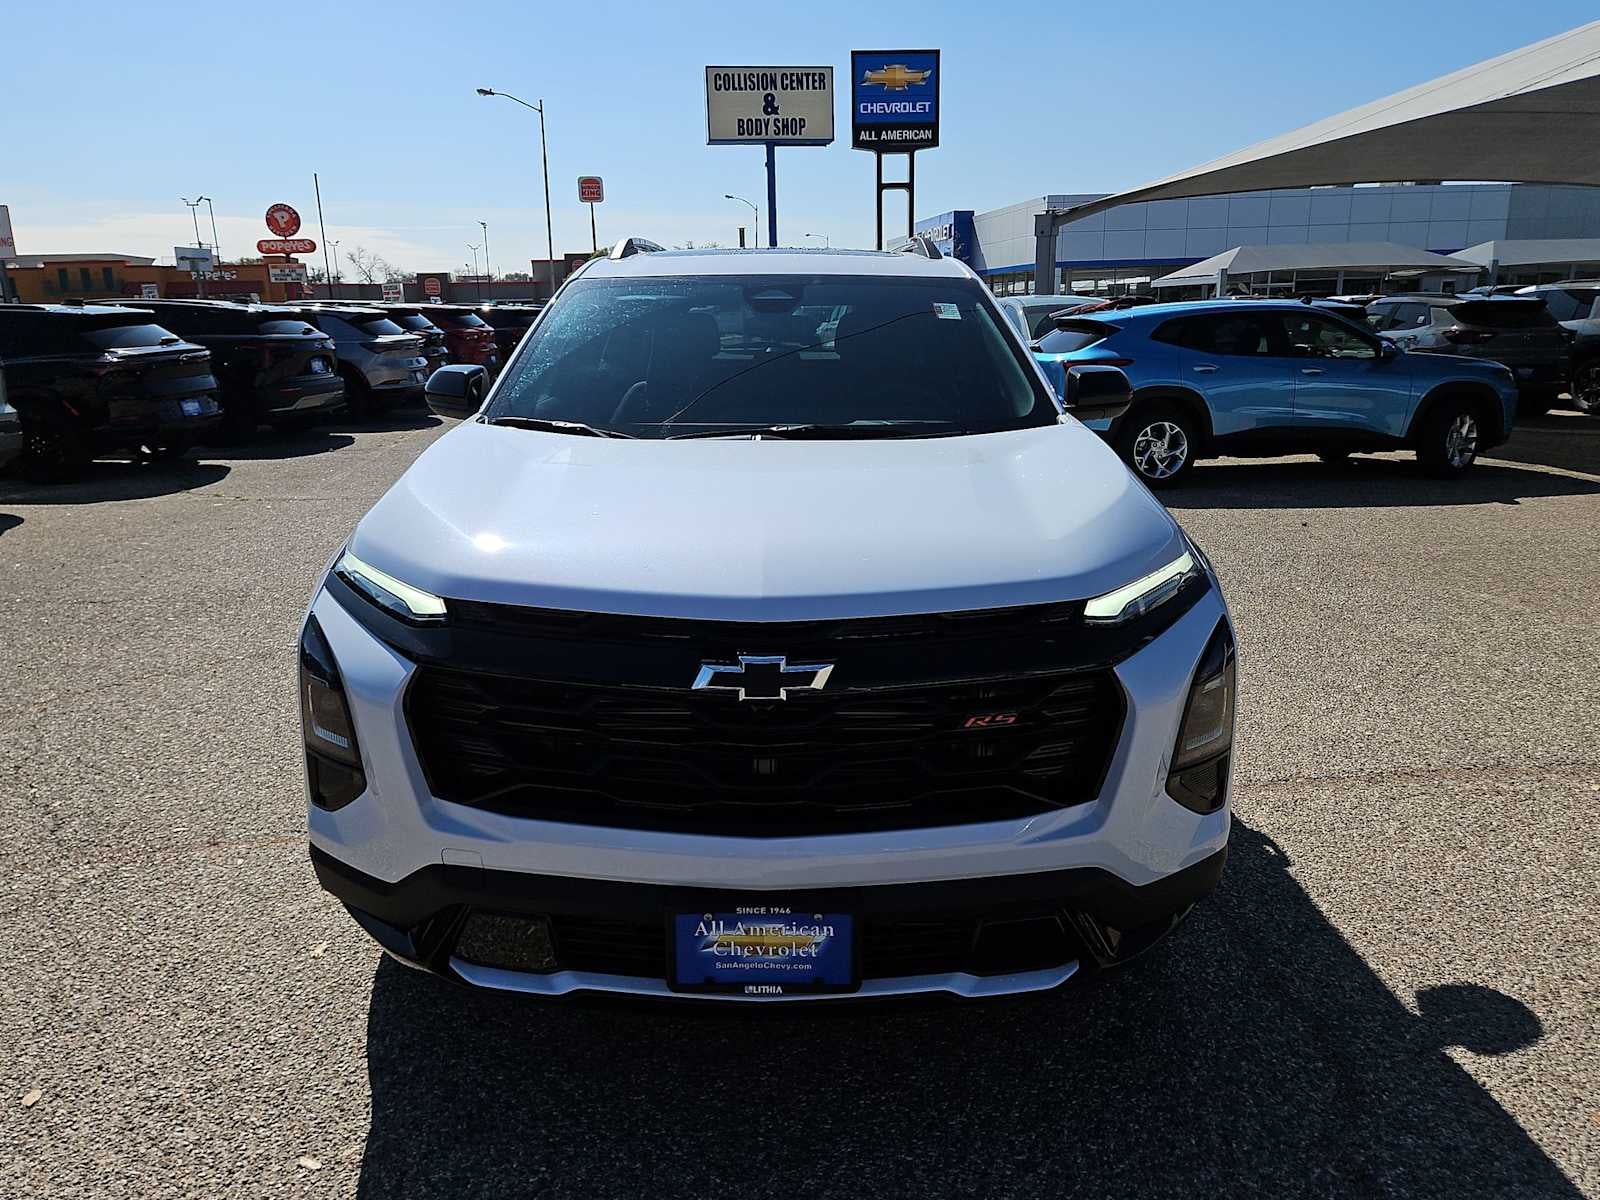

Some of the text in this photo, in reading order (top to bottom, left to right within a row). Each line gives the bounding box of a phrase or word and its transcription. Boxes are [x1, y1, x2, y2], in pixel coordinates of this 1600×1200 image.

[713, 72, 826, 91] COLLISION CENTER
[762, 92, 780, 116] &
[860, 101, 931, 114] CHEVROLET
[737, 117, 806, 136] BODY SHOP
[859, 129, 932, 141] ALL AMERICAN
[963, 712, 1017, 728] RS
[736, 906, 792, 915] SINCE 1946
[694, 920, 834, 937] All American
[713, 941, 818, 958] Chevrolet
[715, 961, 812, 970] SanAngeloChevy.com
[752, 985, 783, 994] LITHIA
